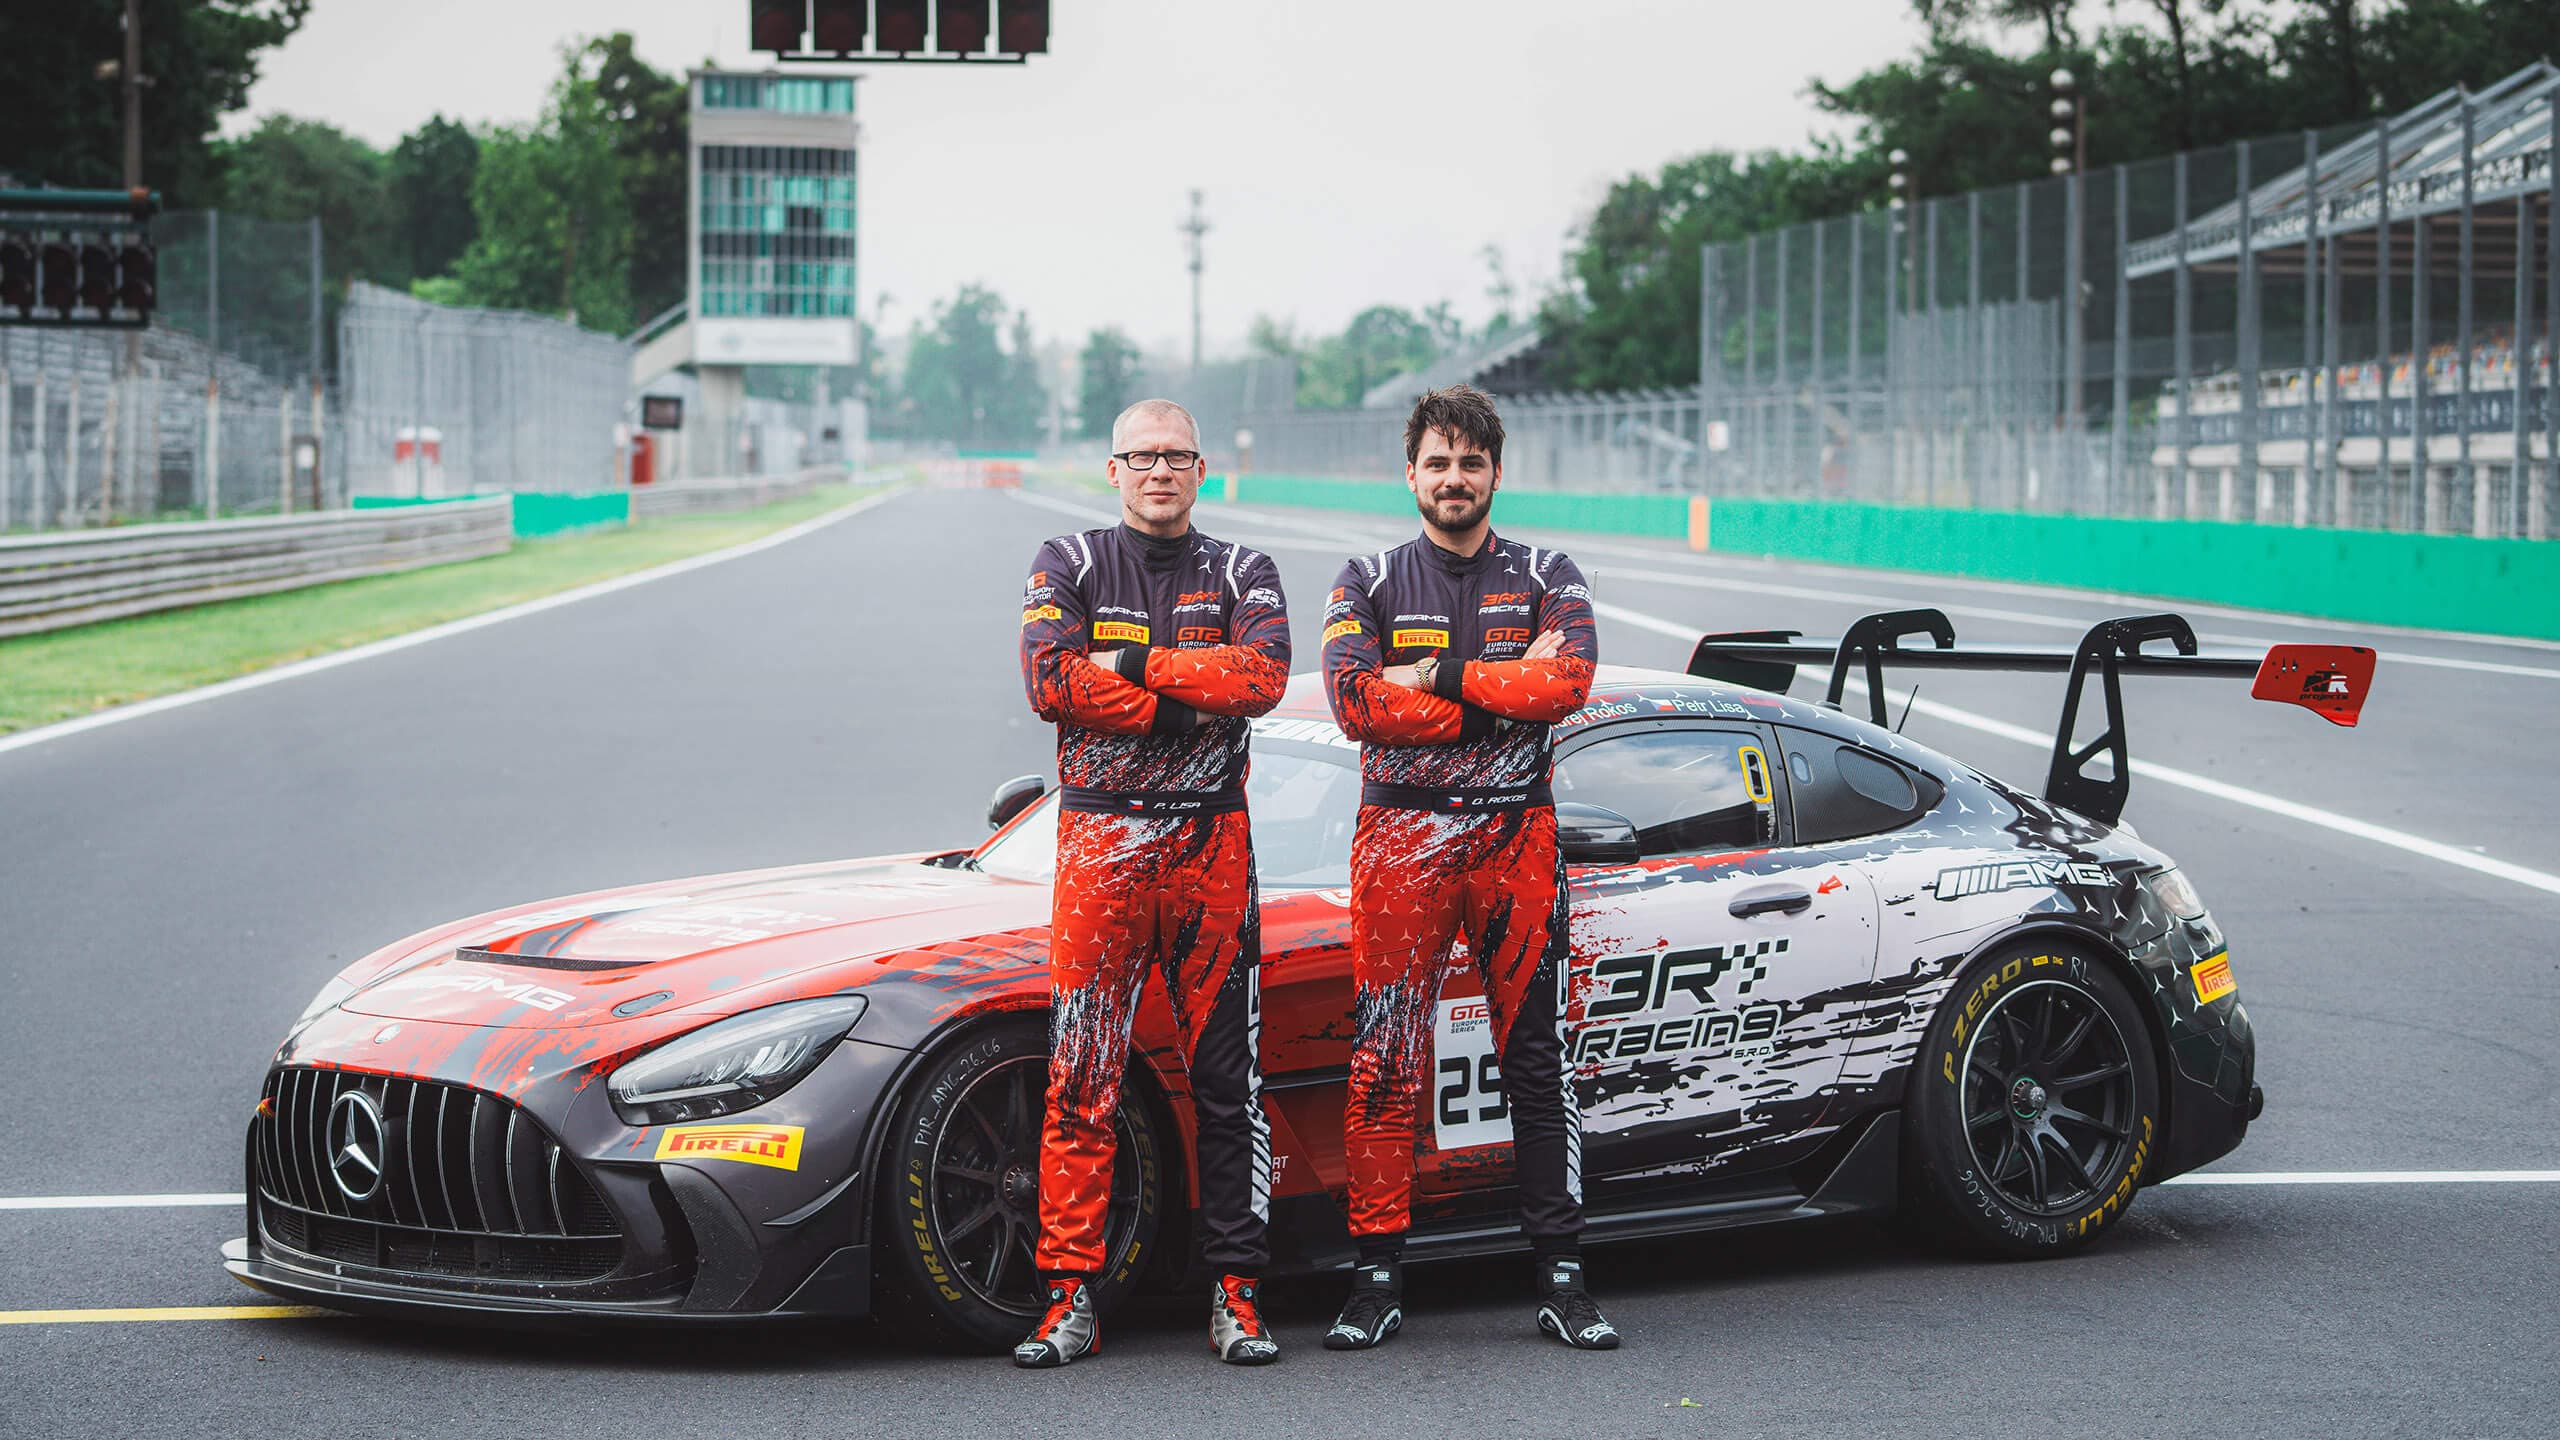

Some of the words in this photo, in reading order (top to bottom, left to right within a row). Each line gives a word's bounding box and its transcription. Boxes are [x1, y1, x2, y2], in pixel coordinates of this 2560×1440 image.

[1412, 614, 1450, 624] AMG
[1098, 624, 1145, 641] PIRELLI
[1176, 626, 1223, 642] GT2
[1397, 631, 1444, 644] PIRELLI
[1484, 627, 1531, 643] GT2
[1589, 701, 1638, 721] Rokos
[1673, 699, 1707, 713] Petr
[1711, 700, 1746, 714] Lisa
[1169, 801, 1201, 810] LISA
[1487, 793, 1528, 805] ROKOS
[1998, 861, 2113, 889] AMG
[1585, 944, 1728, 1020] 3R
[1951, 957, 2022, 1048] ZERO
[1450, 1003, 1490, 1021] GT2
[1450, 1026, 1476, 1034] SERIES
[1451, 1019, 1489, 1029] EUROPEAN
[668, 1131, 790, 1159] PIRELLI
[2079, 1114, 2153, 1237] PIRELLI
[908, 1172, 963, 1301] PIRELLI
